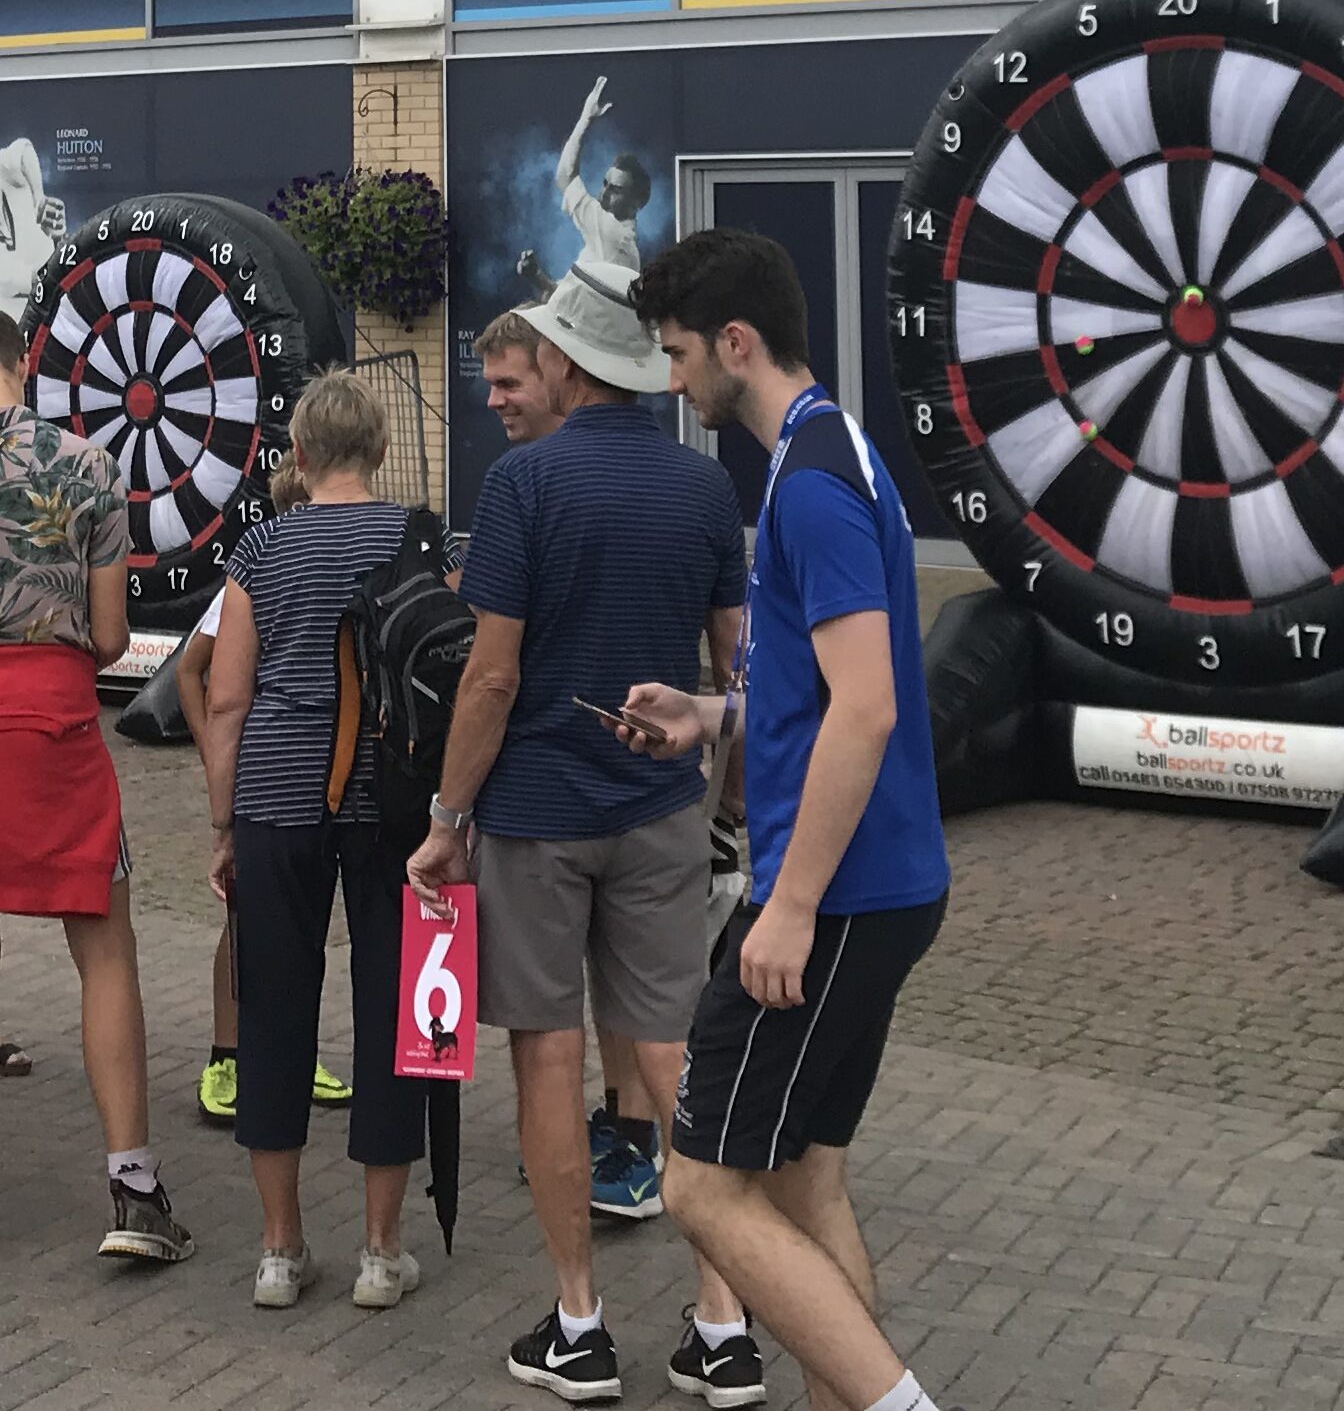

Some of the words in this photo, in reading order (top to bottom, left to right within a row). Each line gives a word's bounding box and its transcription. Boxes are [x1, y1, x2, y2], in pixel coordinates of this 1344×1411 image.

[1078, 4, 1098, 37] 5
[992, 52, 1028, 86] 12
[57, 139, 103, 155] HUTTON
[942, 124, 961, 153] 9
[98, 220, 109, 241] 5
[131, 211, 155, 231] 20
[179, 219, 189, 238] 1
[902, 212, 936, 243] 14
[58, 244, 77, 264] 12
[209, 243, 232, 264] 18
[34, 283, 44, 304] 9
[243, 284, 257, 305] 4
[896, 307, 928, 338] 11
[258, 334, 282, 356] 13
[458, 330, 476, 340] RAY
[459, 342, 478, 359] ILL
[916, 404, 934, 435] 8
[258, 448, 283, 470] 10
[237, 500, 263, 523] 15
[951, 492, 988, 525] 16
[213, 542, 225, 564] 2
[131, 575, 141, 596] 3
[168, 568, 189, 591] 17
[1024, 563, 1044, 592] 7
[1096, 614, 1134, 647] 19
[1286, 624, 1326, 660] 17
[127, 640, 175, 658] sportz
[1199, 637, 1220, 671] 3
[1168, 723, 1287, 754] ballsportz
[1079, 763, 1111, 782] call
[1163, 776, 1226, 793] 654300
[413, 932, 463, 1042] 6
